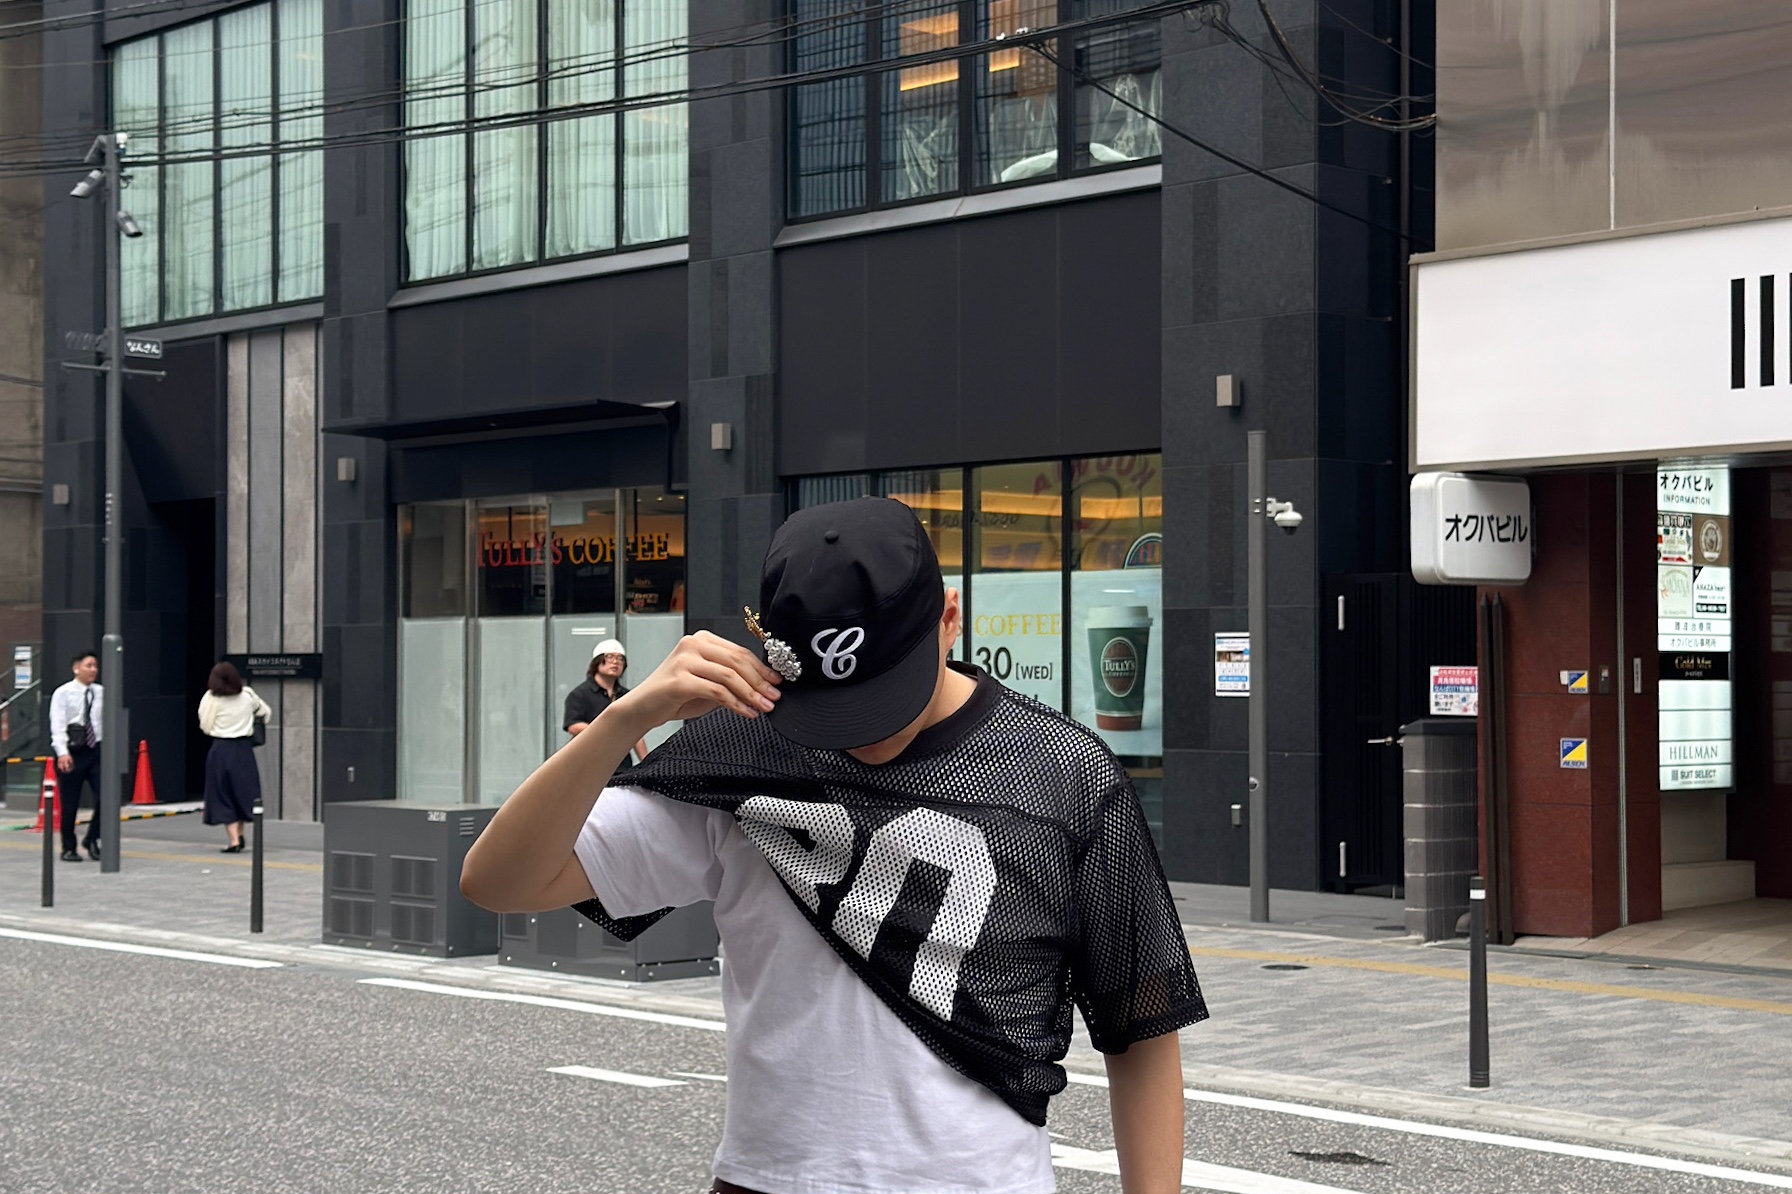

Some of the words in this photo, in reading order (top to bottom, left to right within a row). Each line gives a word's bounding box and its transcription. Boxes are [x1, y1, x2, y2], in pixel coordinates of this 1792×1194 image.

[1660, 473, 1714, 492] オクバビル
[1663, 494, 1711, 506] INFORMATION
[1445, 513, 1528, 543] オクバビル
[974, 613, 1061, 637] COFFEE
[811, 626, 865, 680] C
[975, 646, 1012, 680] 30
[1015, 662, 1053, 681] [WED]
[1669, 745, 1718, 760] HILLMAN
[1695, 768, 1716, 779] SELECT
